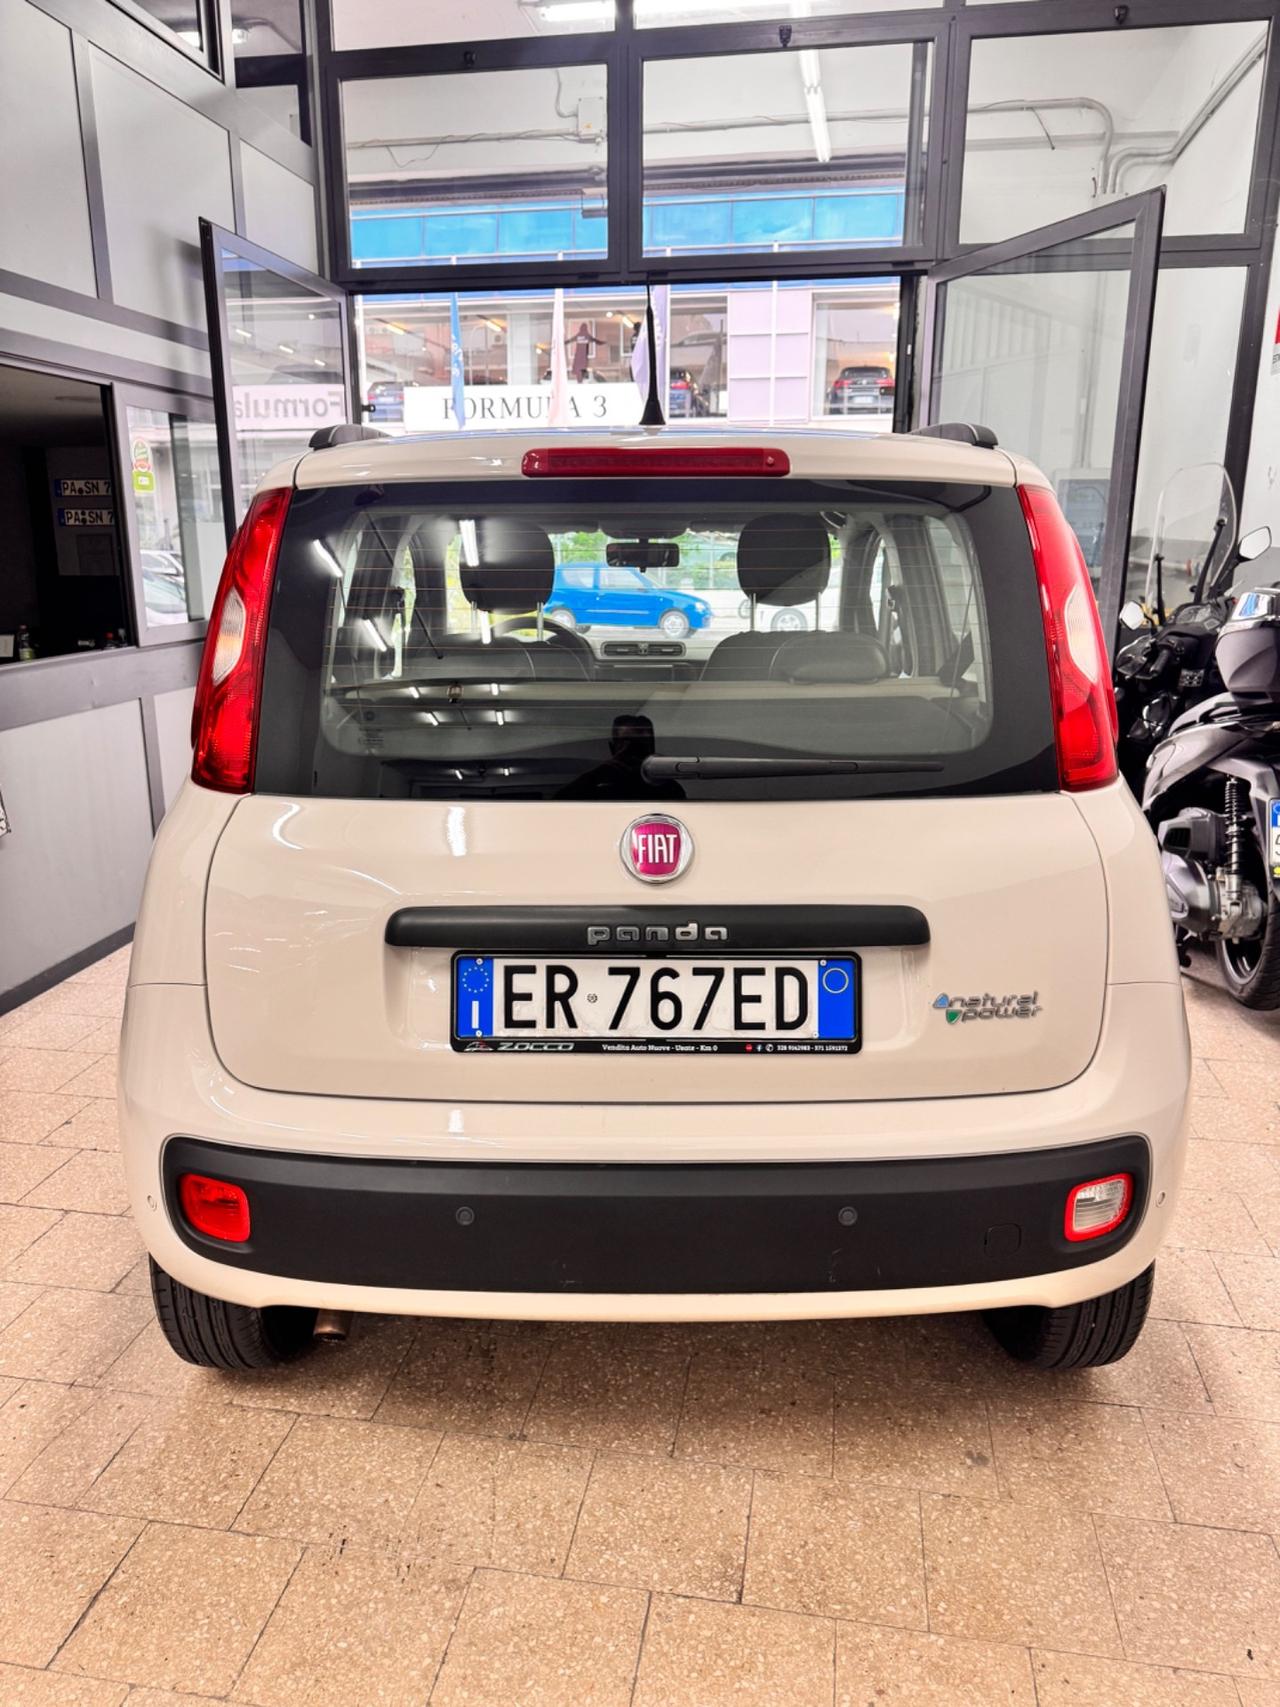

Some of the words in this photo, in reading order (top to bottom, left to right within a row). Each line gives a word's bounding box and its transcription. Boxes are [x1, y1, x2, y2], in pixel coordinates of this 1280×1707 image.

[593, 395, 607, 418] 3
[638, 834, 677, 864] FIAT
[587, 922, 728, 946] panda
[503, 965, 579, 1029] ER
[607, 966, 808, 1030] 767ED
[948, 991, 1039, 1008] natural
[961, 1005, 1043, 1022] power
[497, 1042, 575, 1051] ZOCCO
[630, 1044, 647, 1052] Auto
[648, 1044, 670, 1052] Nuove
[700, 1044, 712, 1052] Km
[712, 1044, 718, 1052] 0
